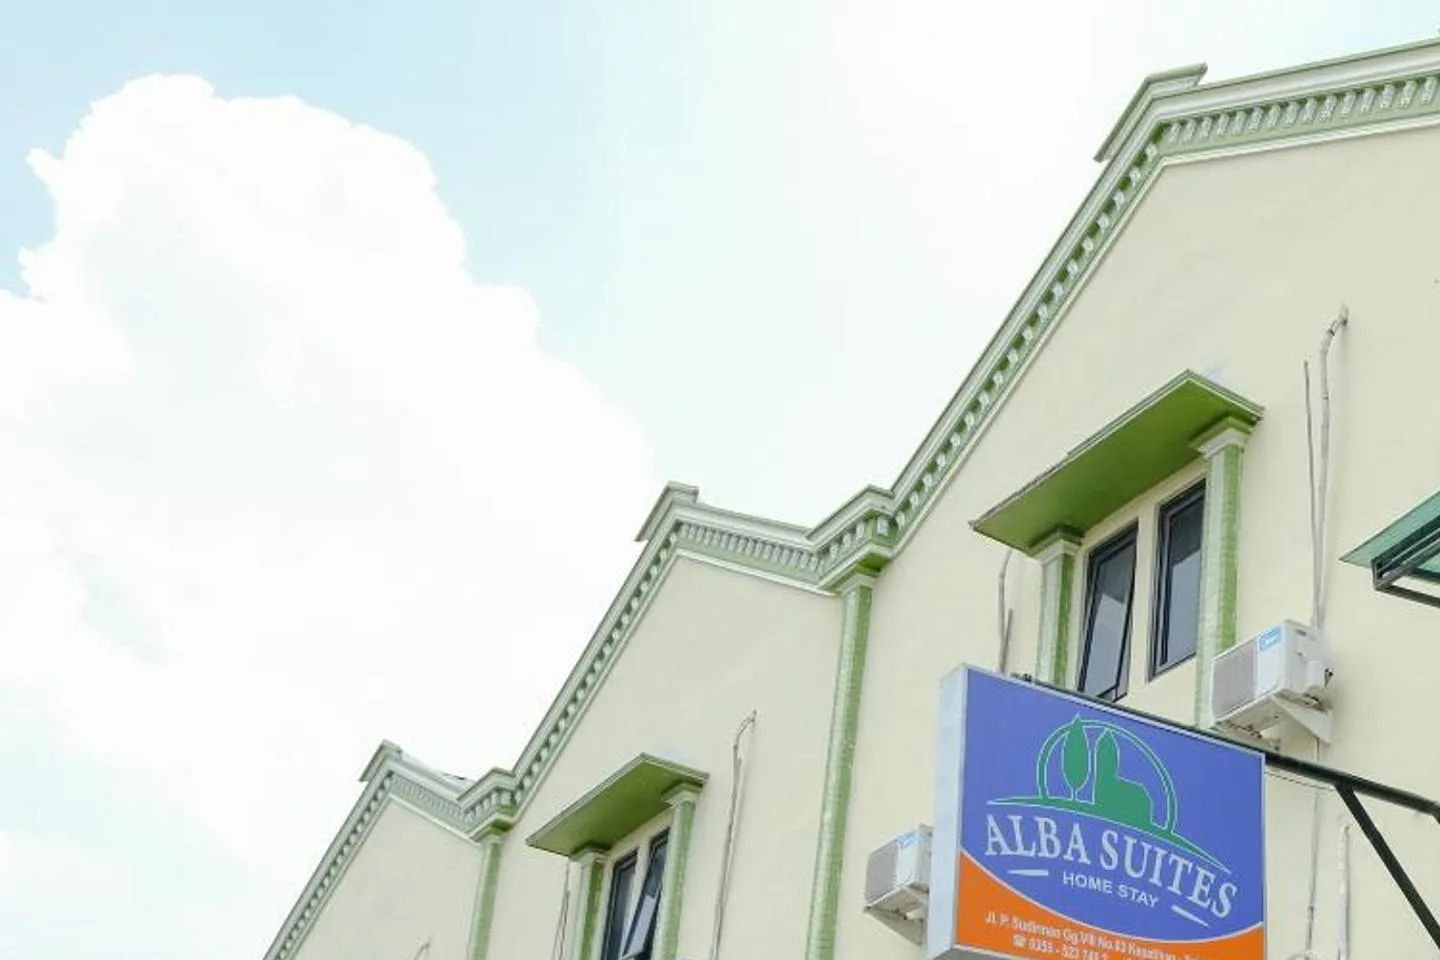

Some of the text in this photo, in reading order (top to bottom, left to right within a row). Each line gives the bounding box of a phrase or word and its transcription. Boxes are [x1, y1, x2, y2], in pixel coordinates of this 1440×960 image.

[984, 813, 1238, 919] ALBA SUITES
[1062, 871, 1159, 908] HOME STAY
